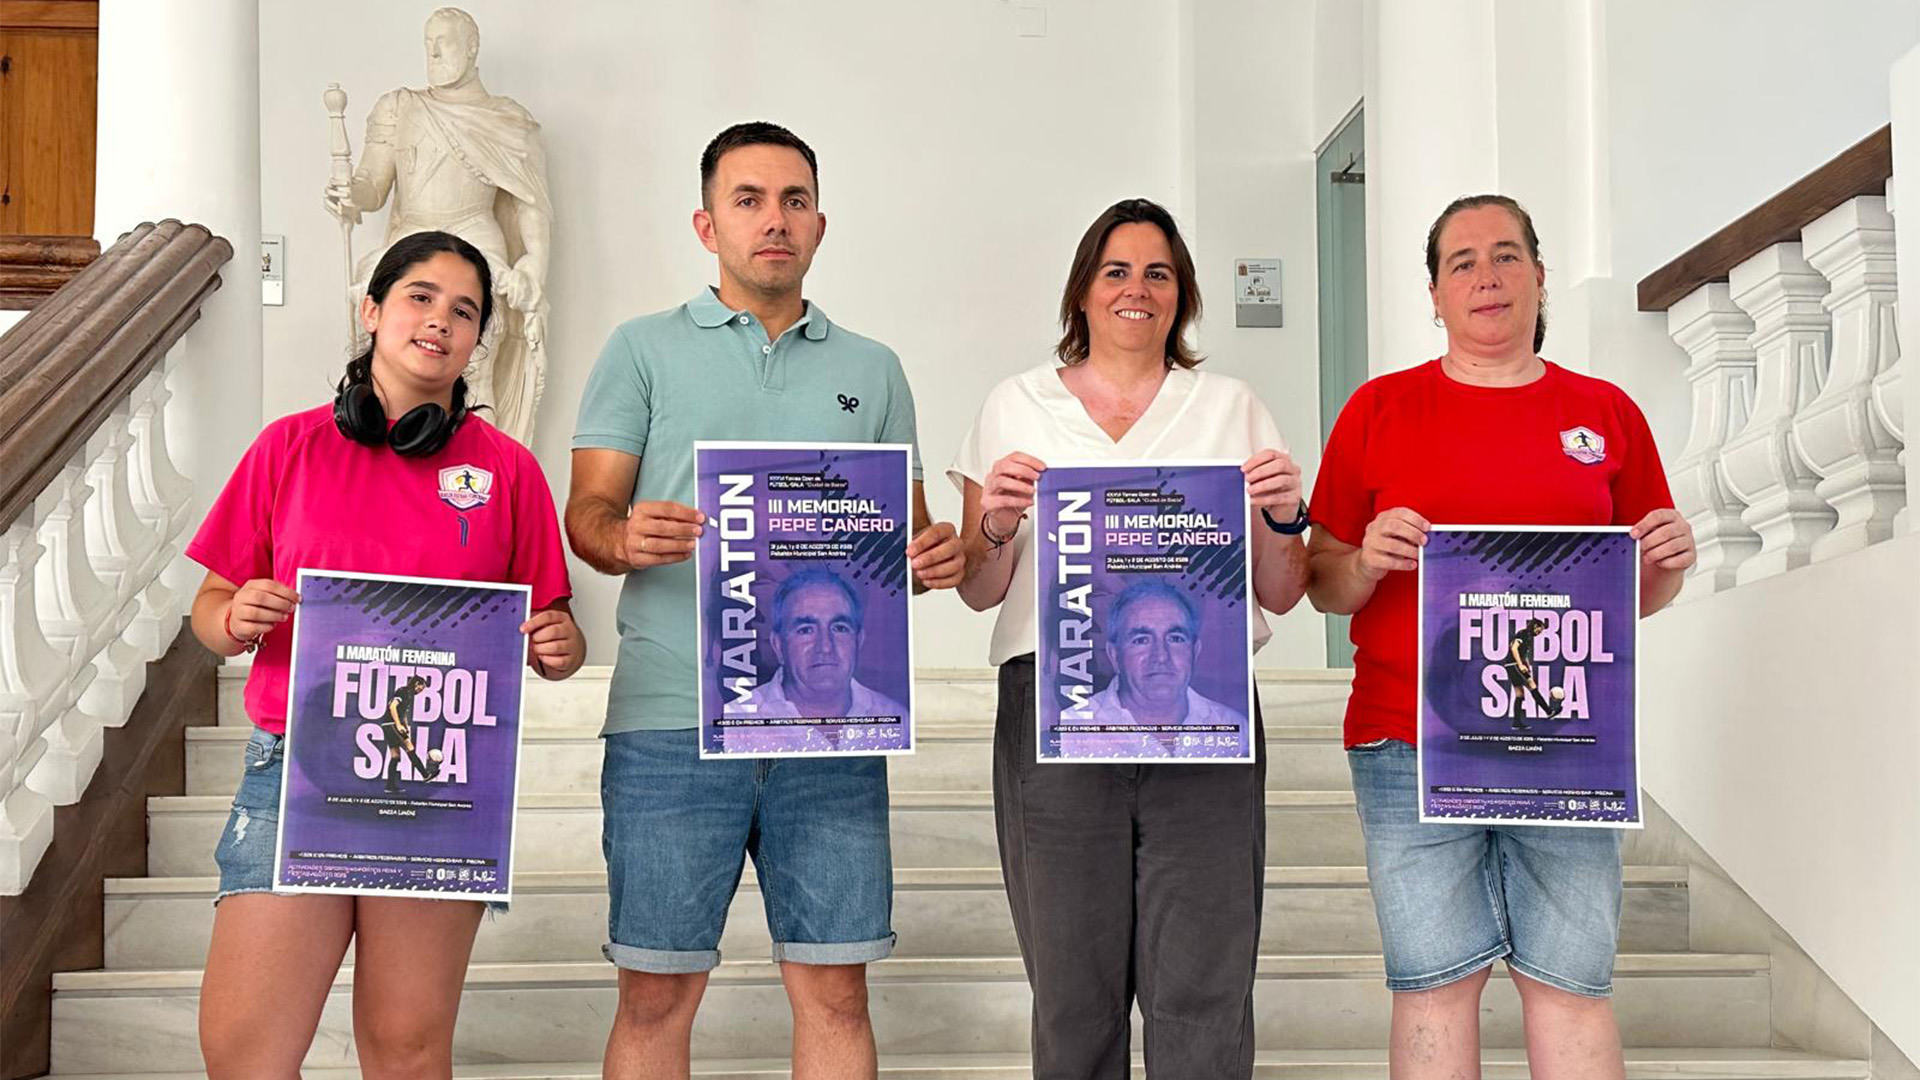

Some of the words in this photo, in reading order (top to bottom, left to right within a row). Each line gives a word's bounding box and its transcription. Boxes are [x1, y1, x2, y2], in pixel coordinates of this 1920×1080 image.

[768, 499, 782, 514] III
[788, 499, 881, 514] MEMORIAL
[769, 518, 817, 532] PEPE
[821, 514, 894, 532] CAÑERO
[1105, 514, 1119, 529] III
[1124, 514, 1218, 529] MEMORIAL
[1106, 532, 1153, 546] PEPE
[1157, 528, 1231, 546] CAÑERO
[709, 474, 757, 713] MARATÓN
[1468, 592, 1517, 607] MARATÓN
[1520, 594, 1571, 608] FEMENINA
[1048, 491, 1094, 720] MARATÓN
[1458, 606, 1614, 663] FÚTBOL
[346, 645, 399, 663] MARATÓN
[402, 649, 456, 667] FEMENINA
[332, 660, 497, 727] FÚTBOL
